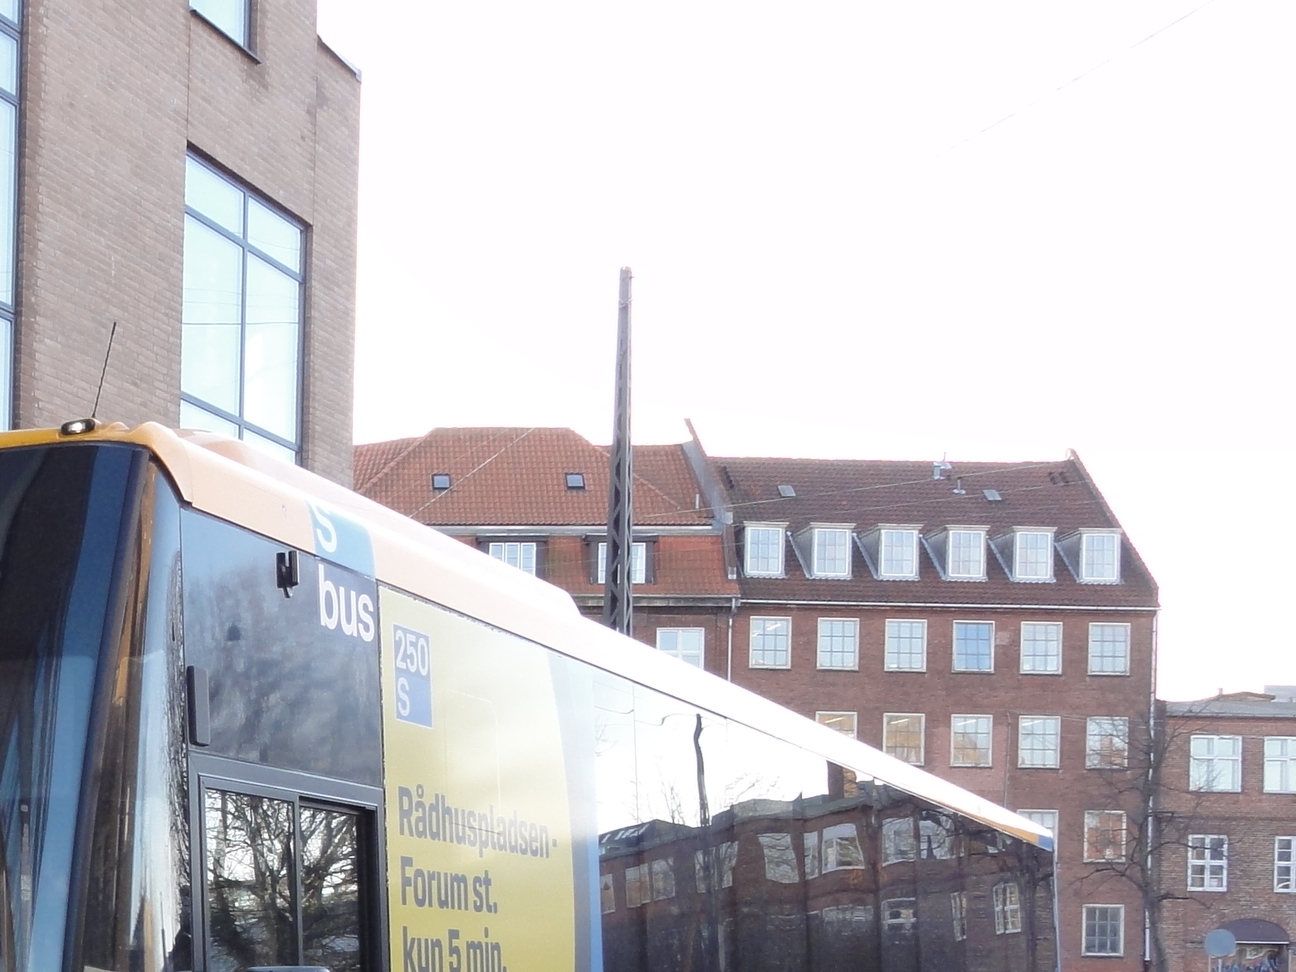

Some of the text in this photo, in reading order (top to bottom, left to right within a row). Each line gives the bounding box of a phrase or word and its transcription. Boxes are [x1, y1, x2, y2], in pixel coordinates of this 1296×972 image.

[315, 504, 337, 552] S
[318, 564, 375, 643] bus
[395, 630, 429, 676] 250
[397, 678, 410, 717] S
[400, 856, 498, 914] Forum st.
